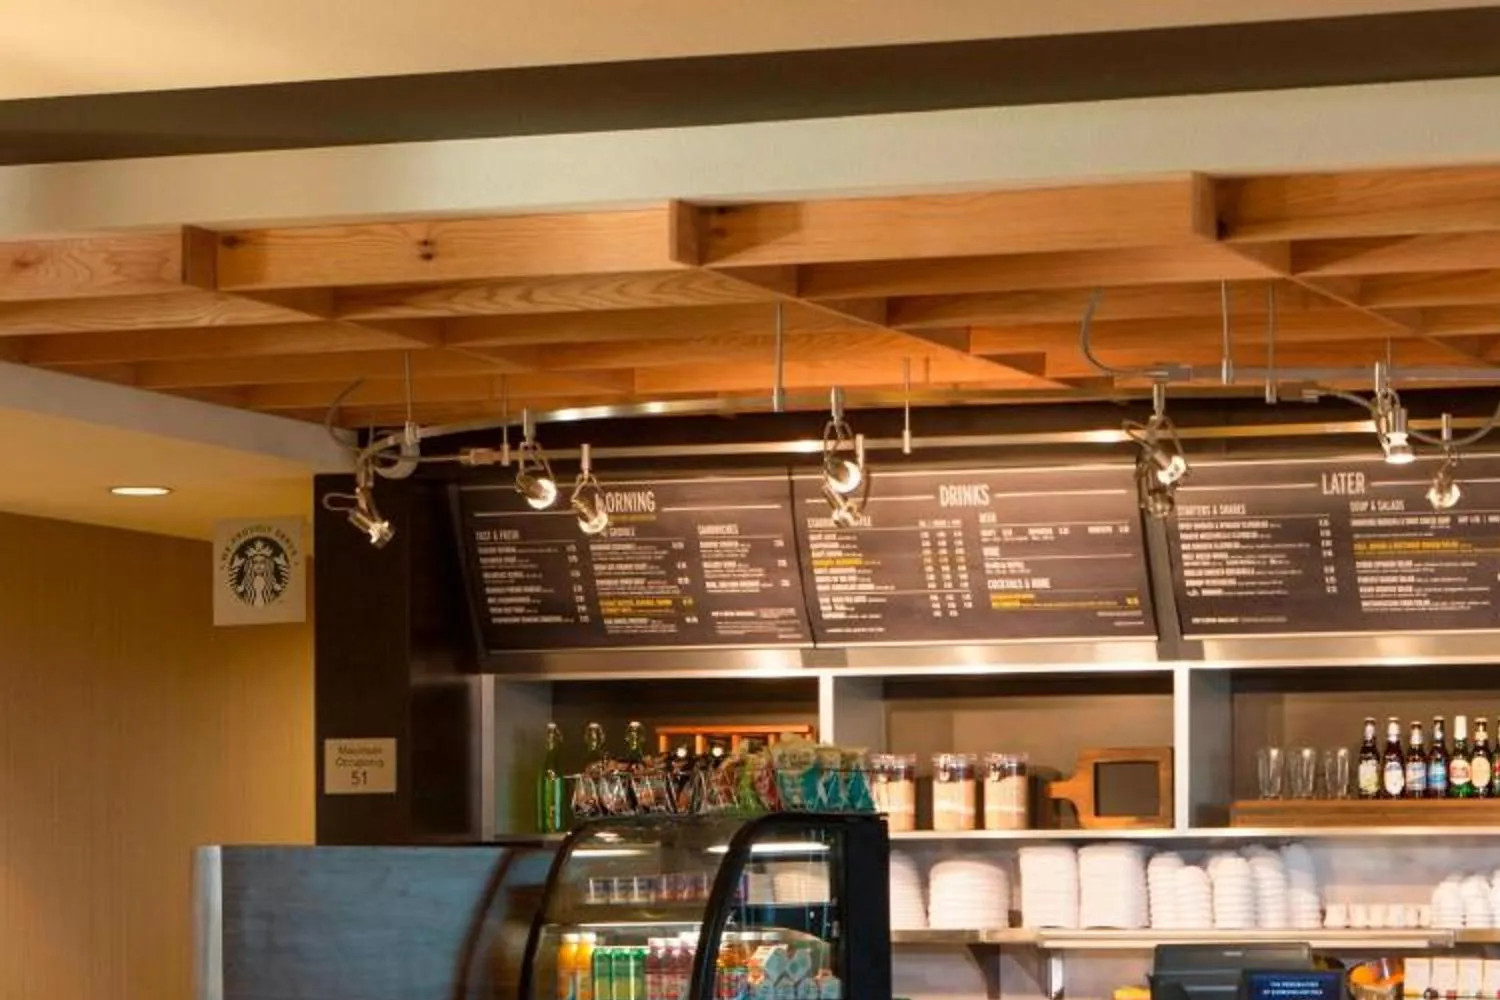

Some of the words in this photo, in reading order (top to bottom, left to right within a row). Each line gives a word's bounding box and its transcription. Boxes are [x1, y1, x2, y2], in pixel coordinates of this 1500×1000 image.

[939, 484, 990, 507] DRINKS
[1321, 473, 1365, 496] LATER
[351, 770, 368, 785] 51
